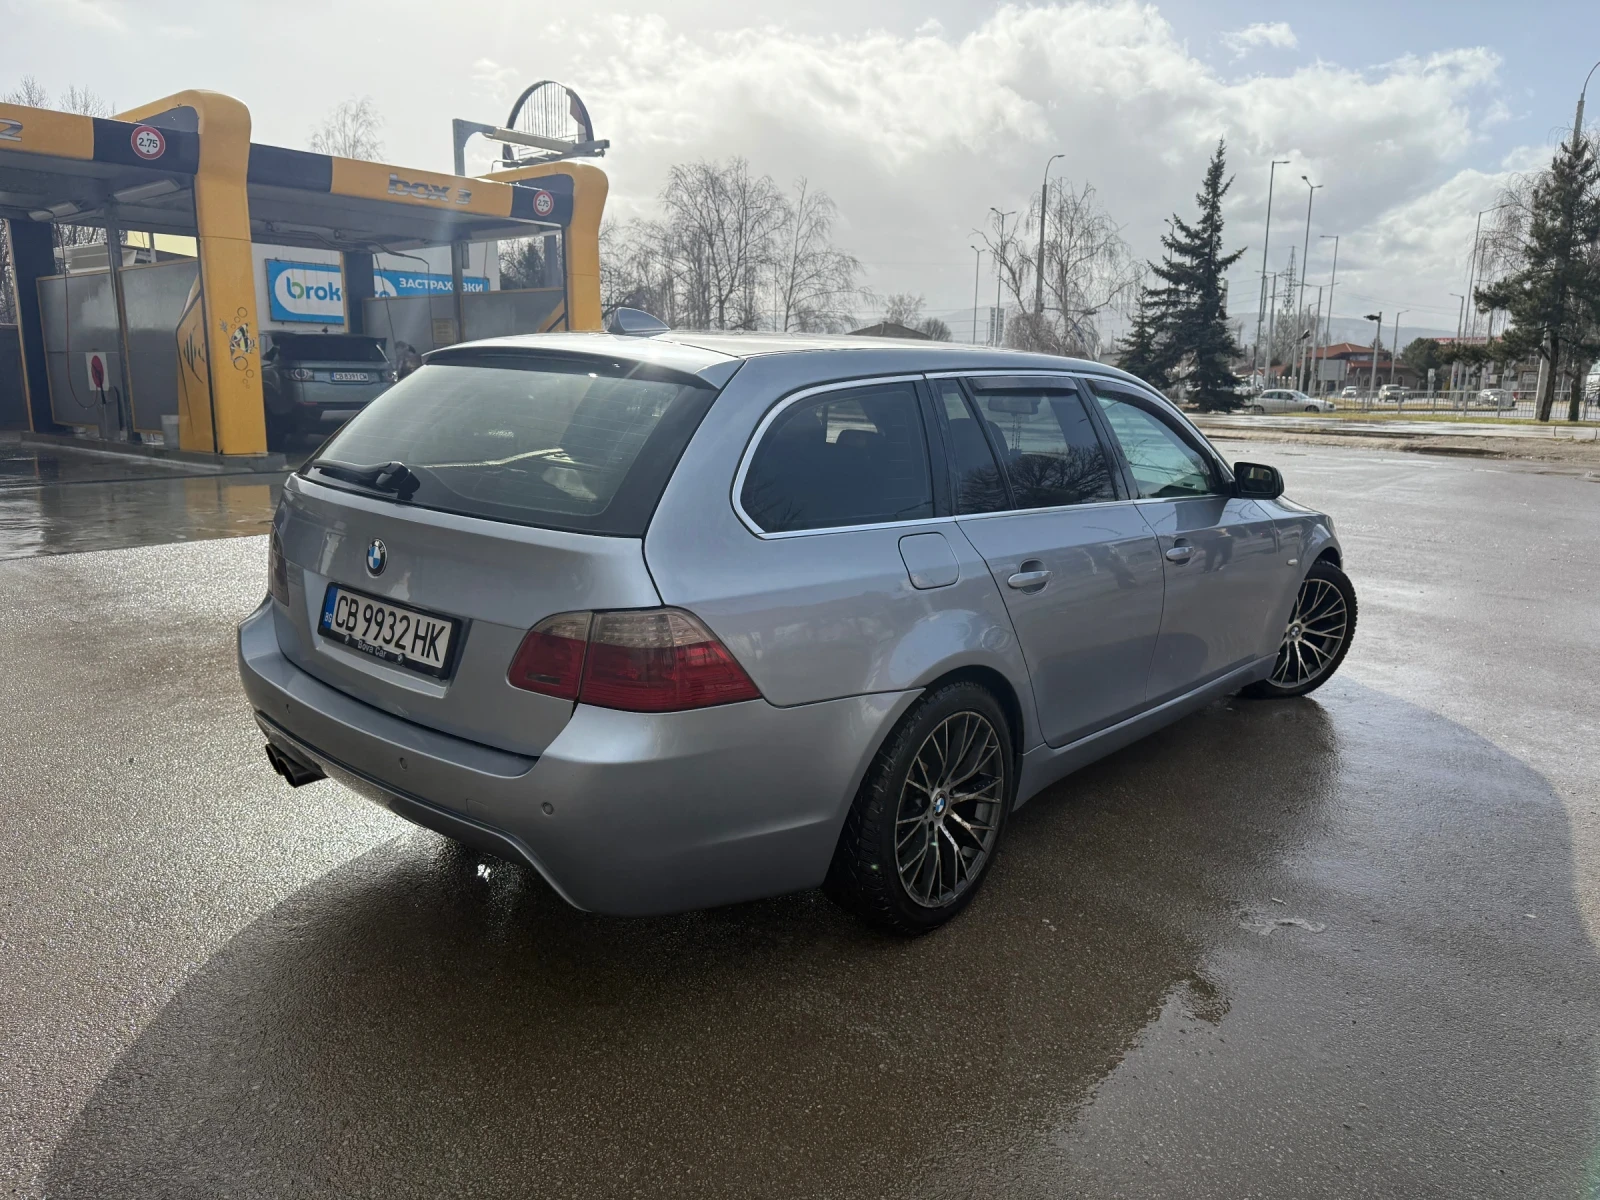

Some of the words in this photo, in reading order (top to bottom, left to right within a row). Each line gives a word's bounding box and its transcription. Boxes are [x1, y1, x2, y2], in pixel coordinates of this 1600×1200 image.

[138, 138, 158, 149] 2.75
[388, 173, 450, 202] box
[455, 189, 472, 205] 3
[537, 199, 550, 208] 2.75
